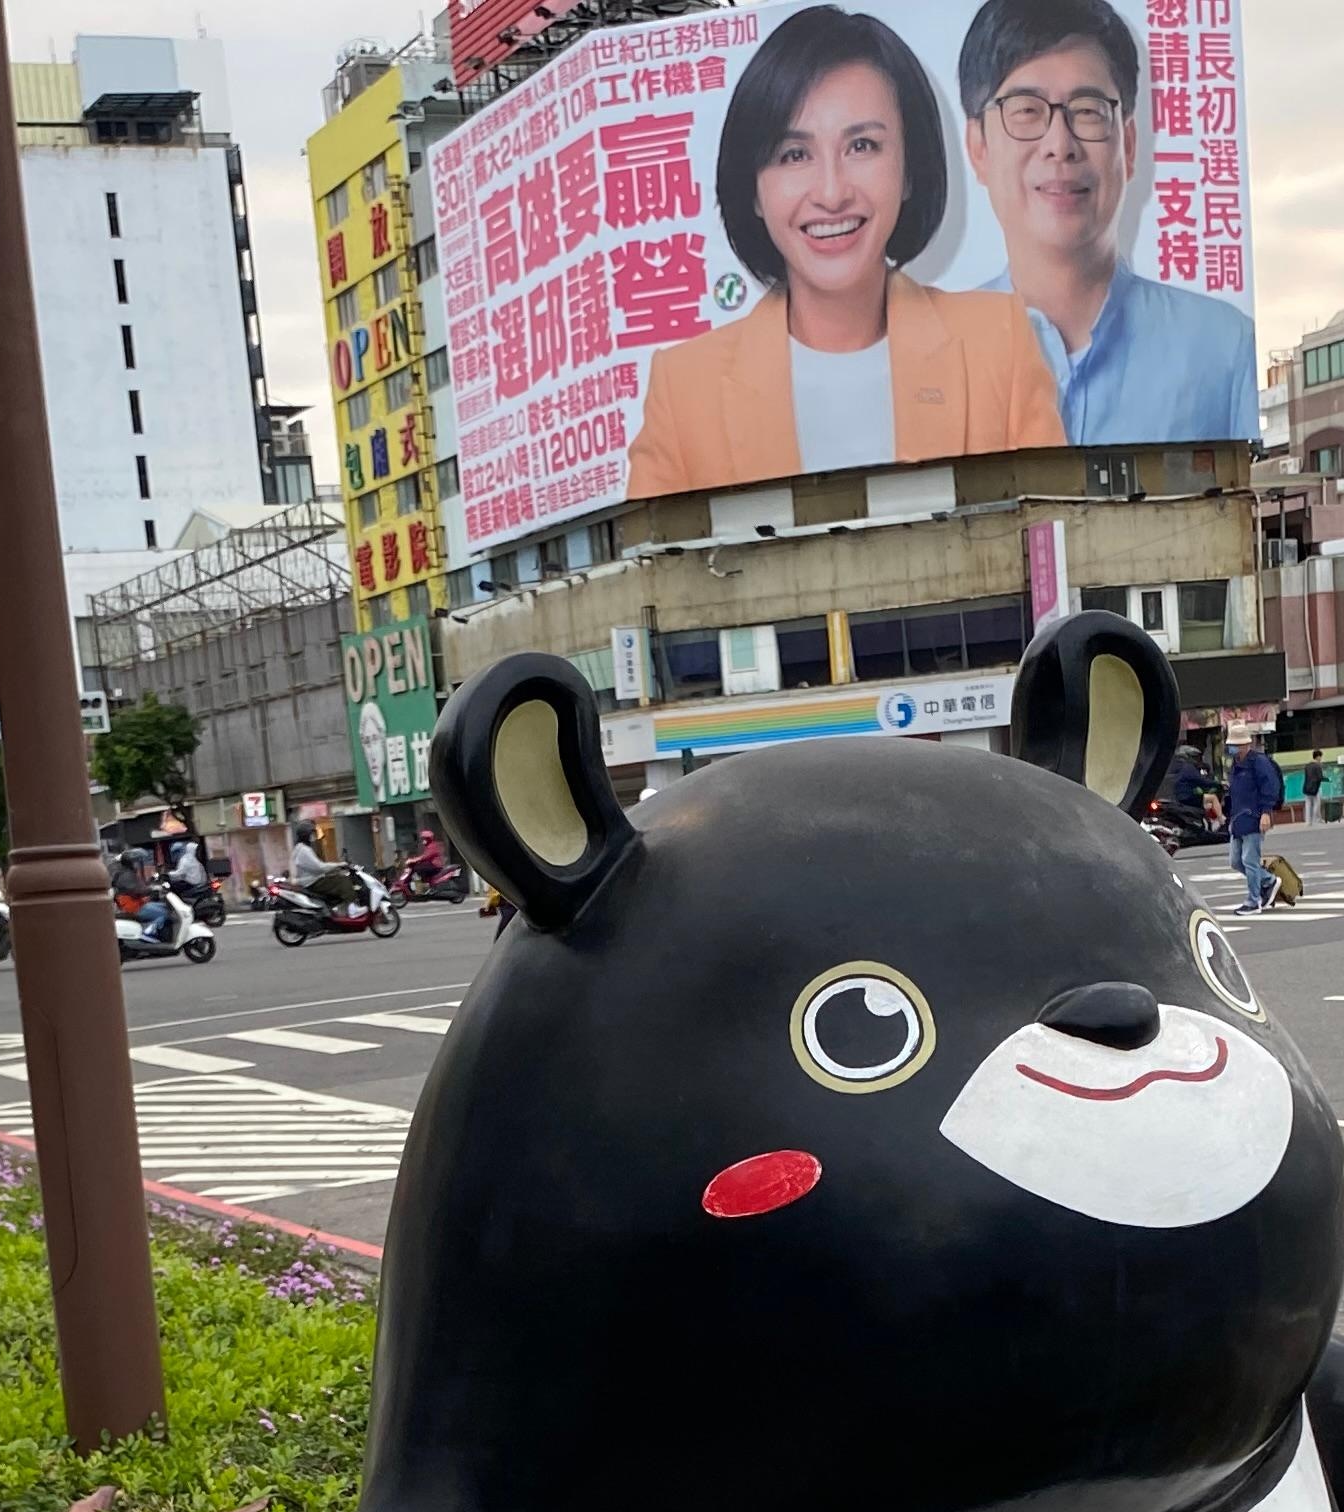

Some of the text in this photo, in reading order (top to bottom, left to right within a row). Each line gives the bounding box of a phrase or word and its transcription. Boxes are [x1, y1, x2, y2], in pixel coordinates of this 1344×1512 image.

[480, 111, 701, 297] 高雄要贏
[332, 302, 415, 391] OPEN
[491, 232, 712, 405] 選邱議瑩
[343, 625, 429, 703] OPEN
[923, 693, 995, 716] 中華電信
